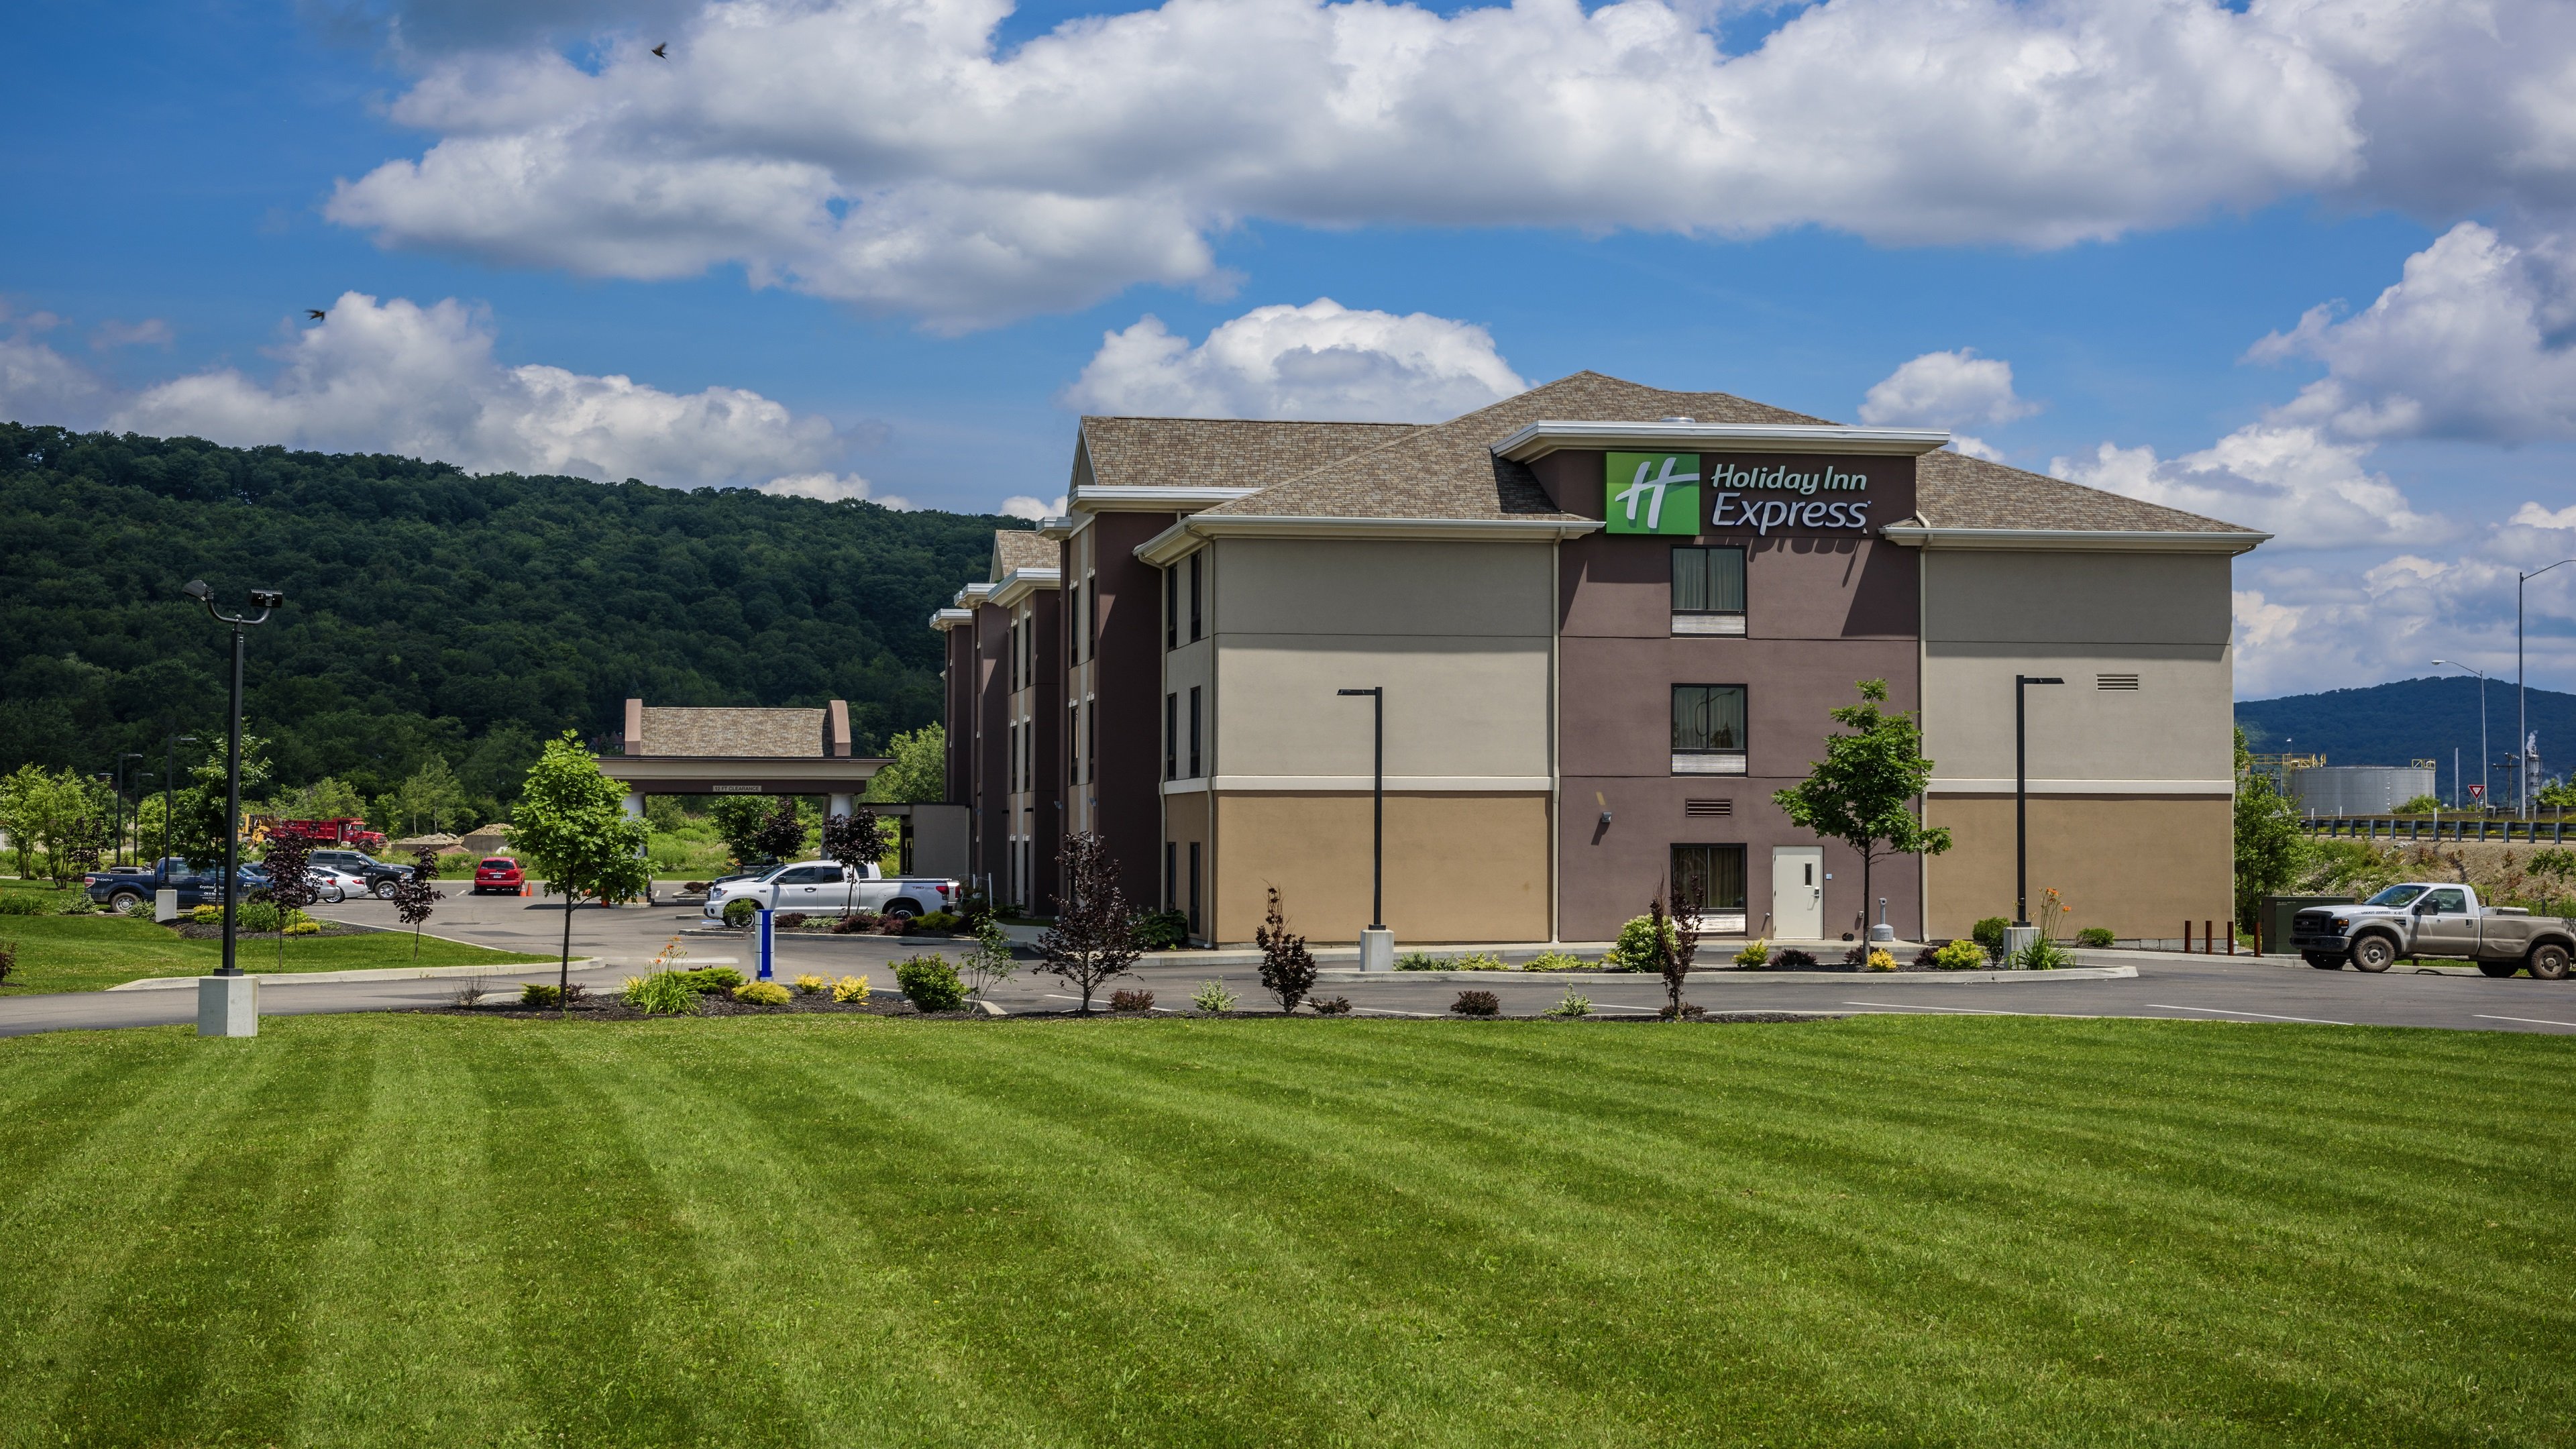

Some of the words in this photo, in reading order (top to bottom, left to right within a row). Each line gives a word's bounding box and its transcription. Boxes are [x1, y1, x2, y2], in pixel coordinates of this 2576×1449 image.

[1711, 464, 1820, 495] Holiday
[1823, 466, 1868, 490] Inn
[1712, 492, 1868, 535] Express
